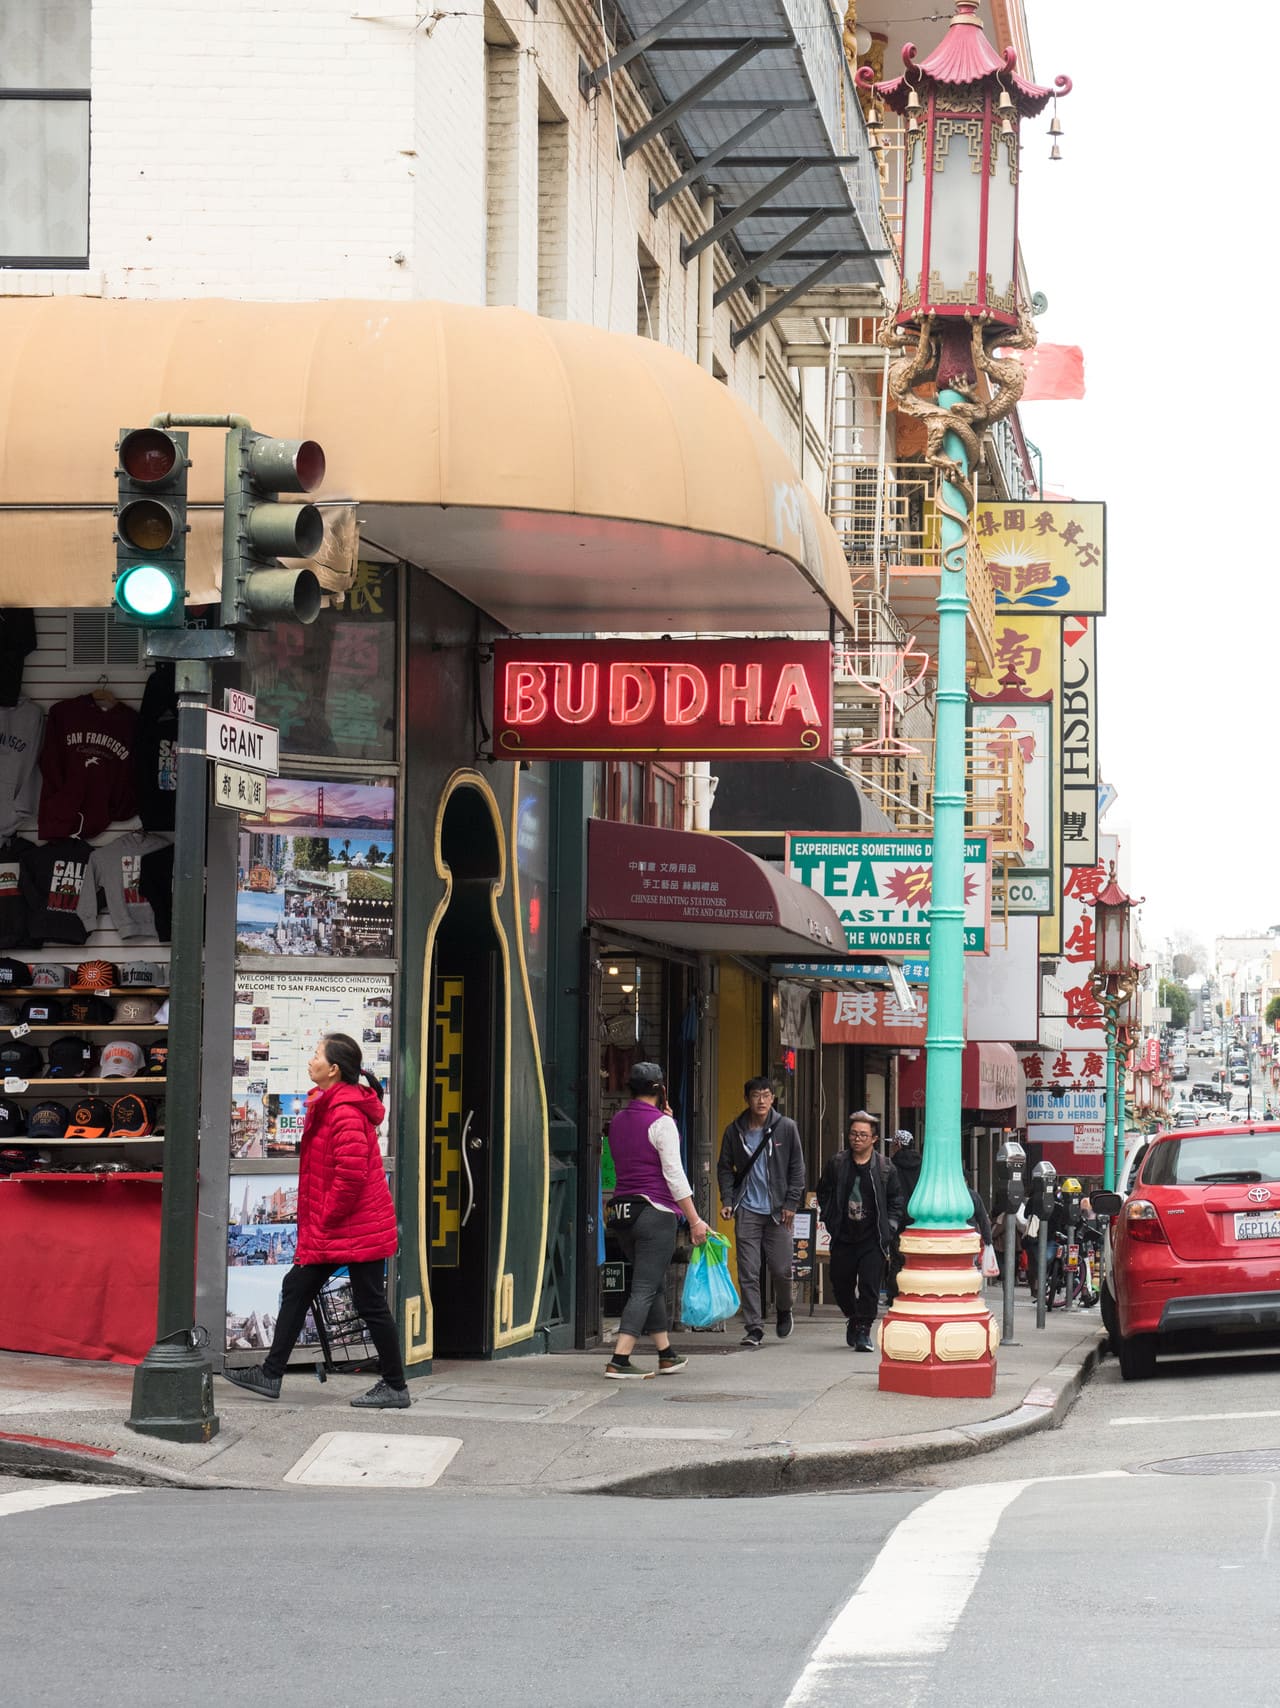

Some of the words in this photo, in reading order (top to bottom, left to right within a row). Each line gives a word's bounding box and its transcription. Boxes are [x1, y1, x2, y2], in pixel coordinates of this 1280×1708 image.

[504, 662, 822, 726] BUDDHA
[232, 693, 247, 714] 900
[1063, 657, 1090, 779] HSBC
[67, 732, 83, 746] SAN
[86, 732, 130, 761] FRANCISCO
[220, 723, 264, 761] GRANT
[221, 773, 262, 805] 都板街
[795, 843, 858, 855] EXPERIENCE
[861, 843, 922, 856] SOMETHING
[793, 859, 879, 896] TEA
[631, 894, 658, 904] CHINESE
[659, 895, 689, 906] PAINTING
[1009, 886, 1036, 900] CO.
[683, 906, 699, 916] ARTS
[700, 908, 713, 917] AND
[714, 908, 738, 918] CRAFTS
[739, 910, 754, 919] SILK
[754, 911, 774, 920] GIFTS
[839, 909, 932, 922] ASTIN
[845, 932, 865, 944] HE
[870, 932, 920, 944] WONDER
[346, 976, 388, 984] CHINATOWN
[237, 983, 275, 991] WELCOME
[305, 985, 347, 993] FRANCISCO
[348, 986, 392, 994] CHINATOWN
[1074, 1094, 1096, 1108] LUNG
[1028, 1110, 1054, 1119] GIFTS
[1068, 1110, 1099, 1119] HERBS
